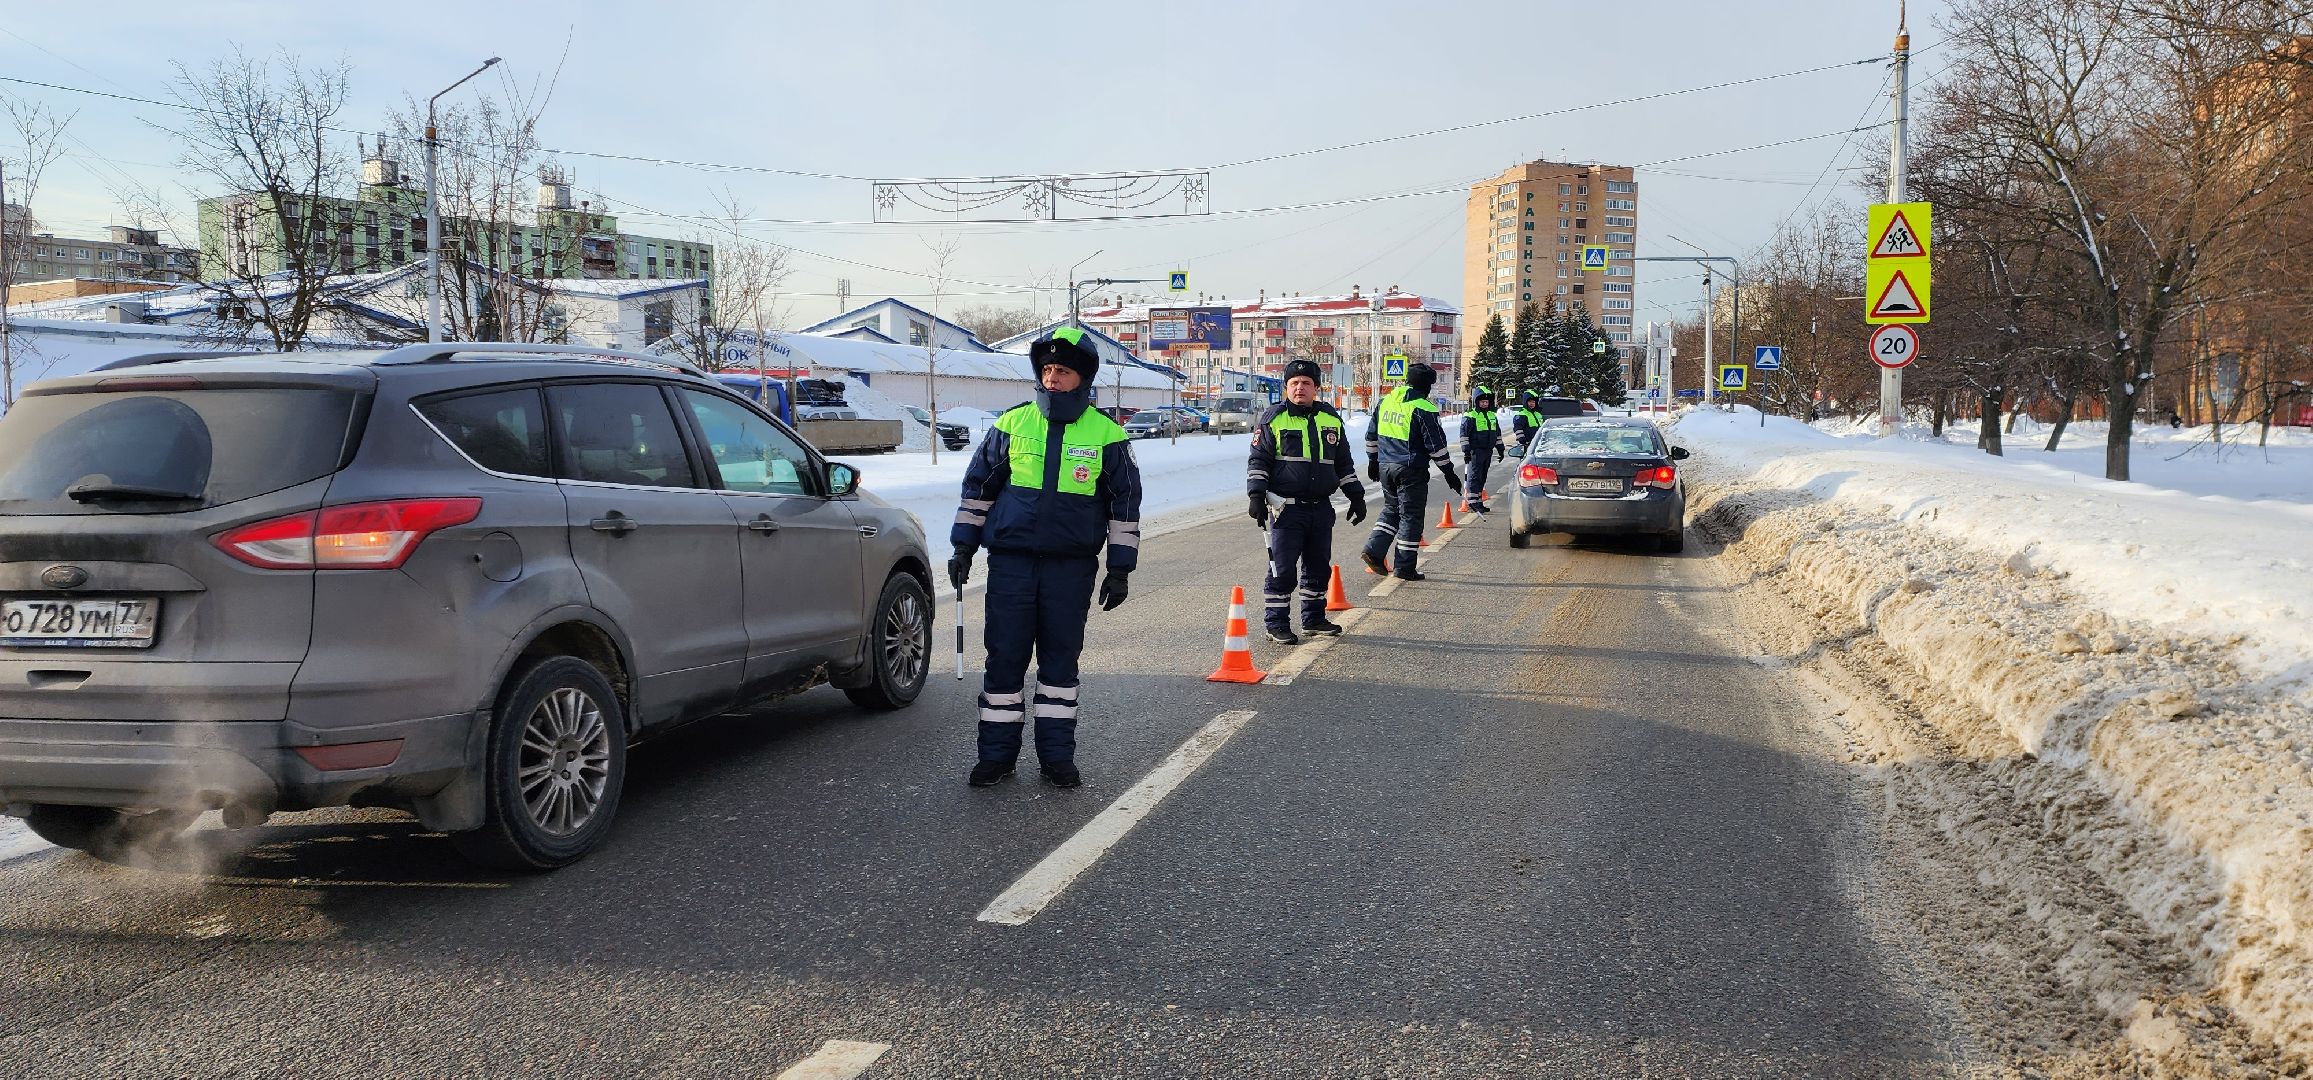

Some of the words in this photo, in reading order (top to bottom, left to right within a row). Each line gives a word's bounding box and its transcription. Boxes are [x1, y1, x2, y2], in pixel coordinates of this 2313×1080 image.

[1522, 192, 1535, 302] РАМЕНСКО
[696, 348, 749, 361] ЫНОК
[1881, 337, 1907, 355] 20
[1382, 410, 1405, 427] ДПС
[119, 602, 147, 625] 77
[115, 624, 136, 634] RUS
